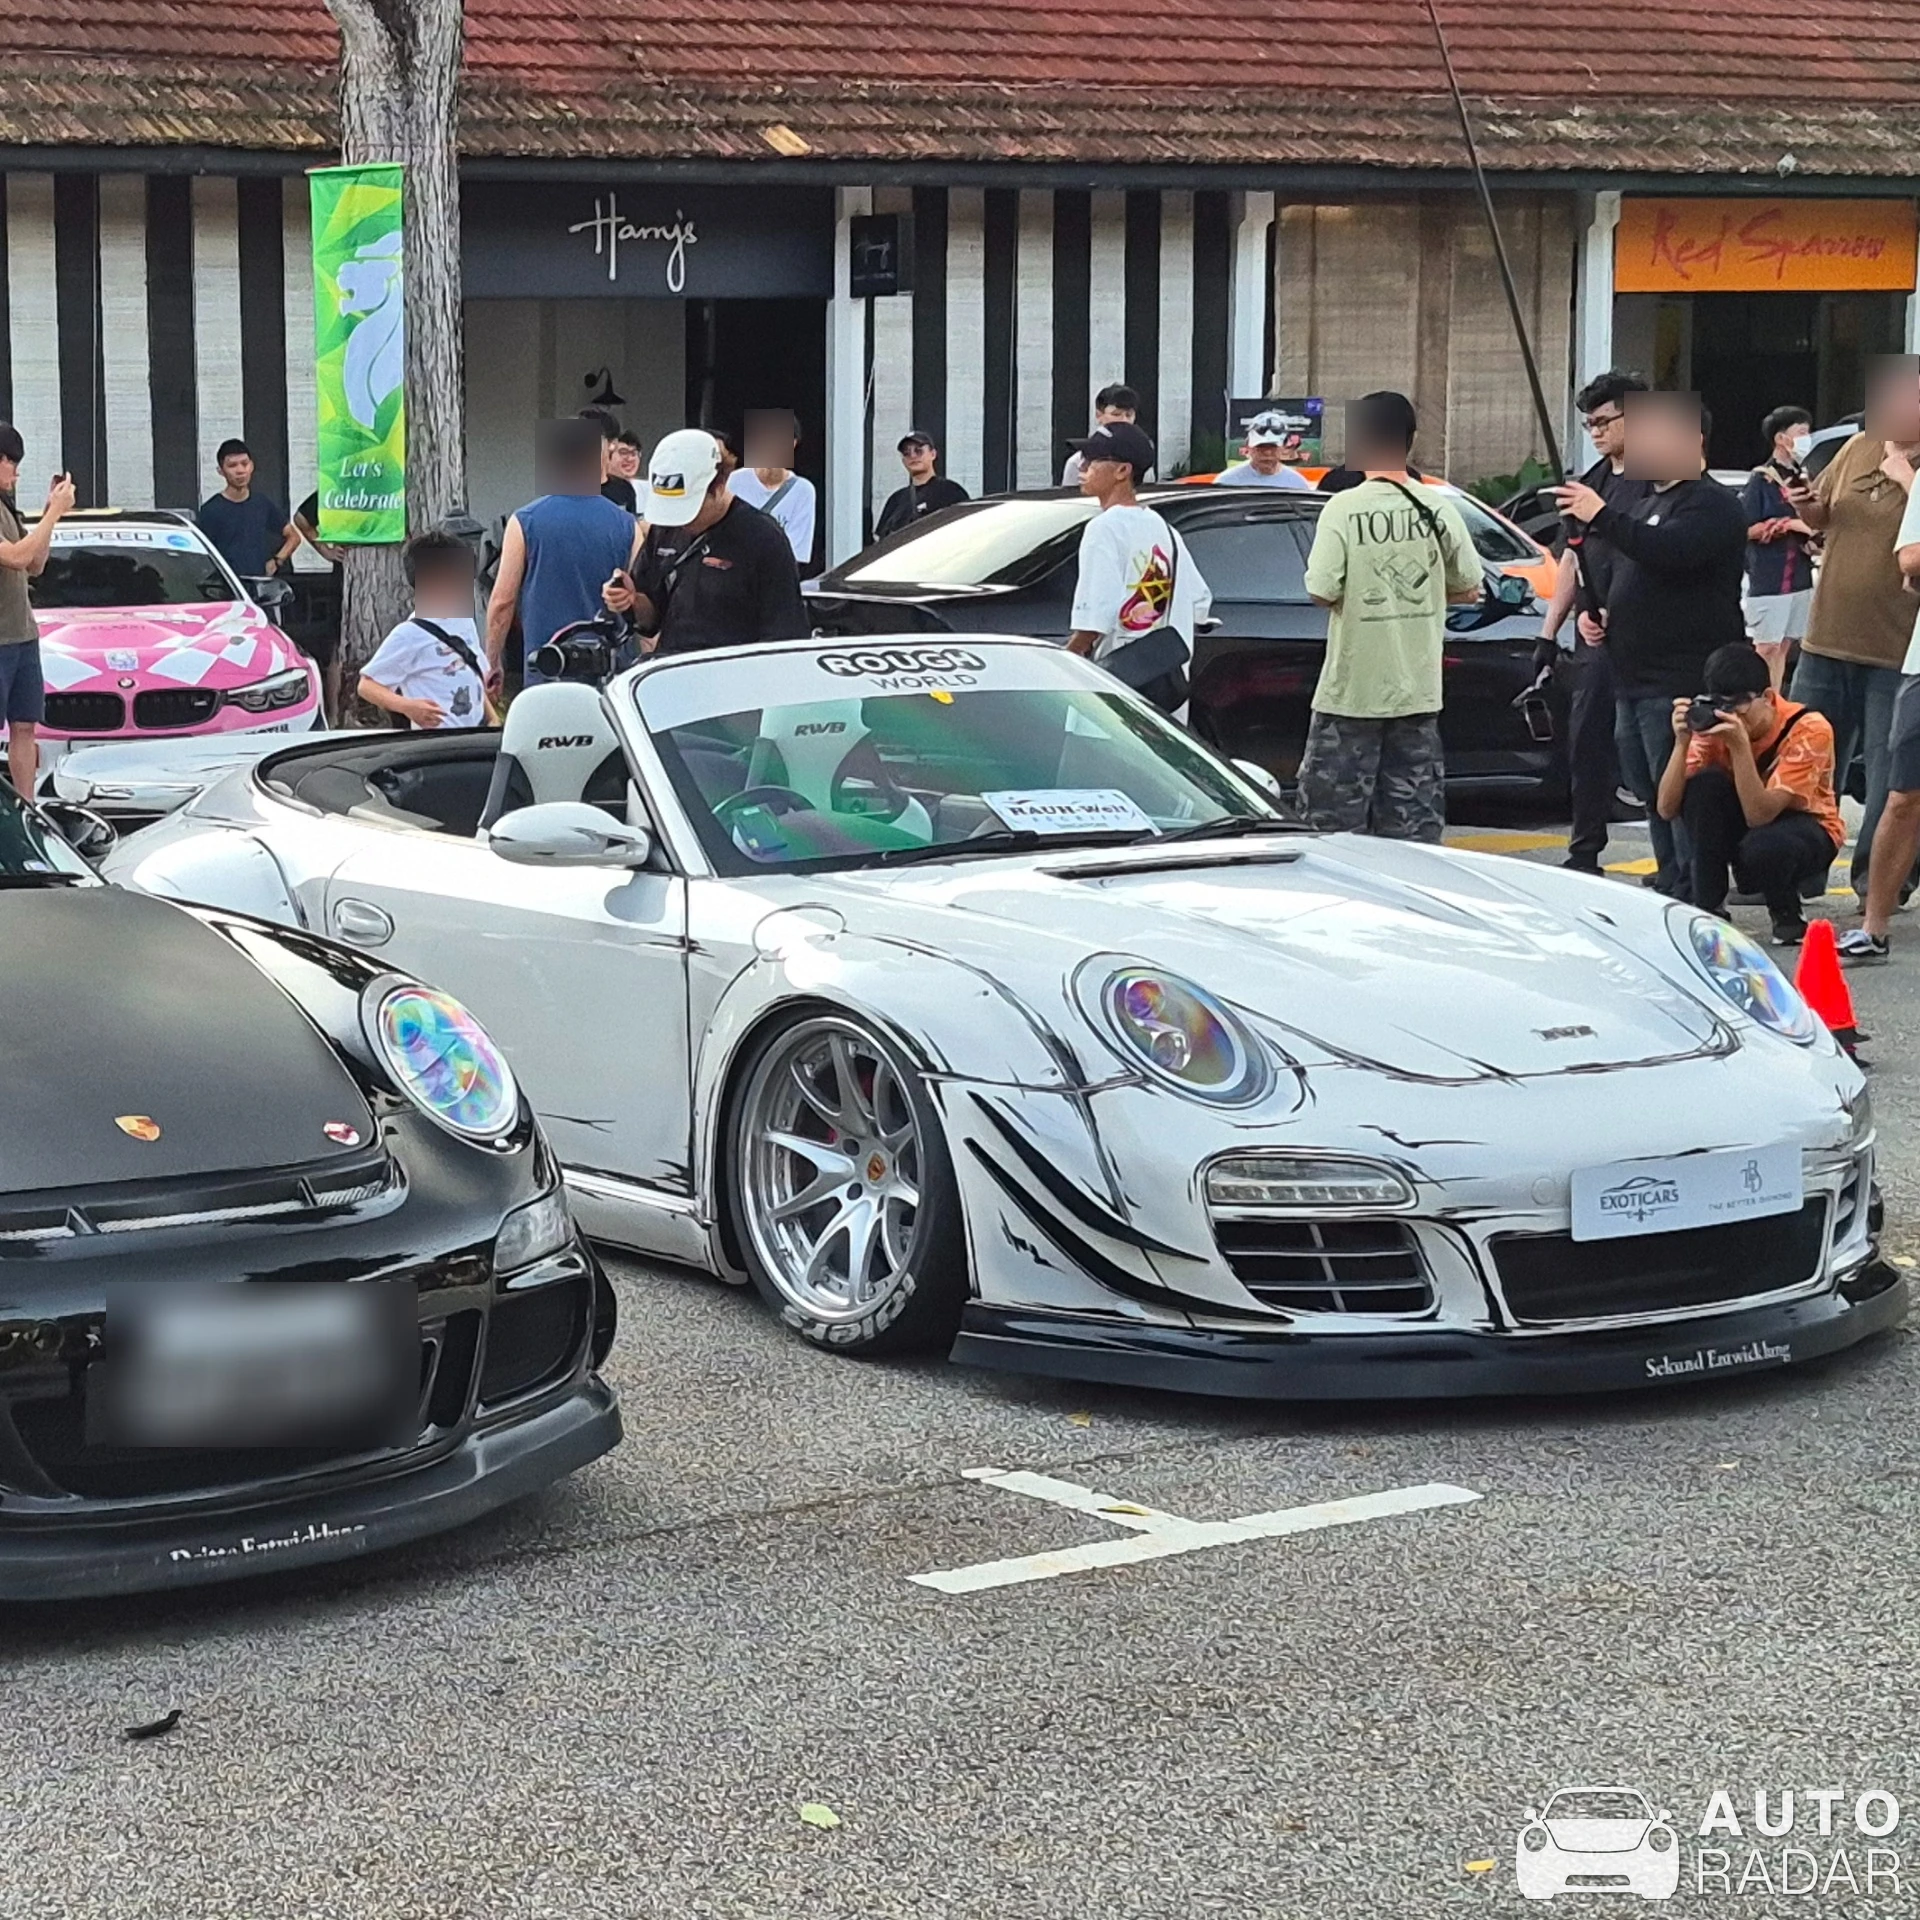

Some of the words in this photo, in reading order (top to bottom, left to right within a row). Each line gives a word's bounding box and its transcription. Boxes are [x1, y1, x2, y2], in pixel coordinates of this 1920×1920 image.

[568, 191, 698, 293] Harry's
[1650, 208, 1736, 281] Red
[1737, 208, 1887, 281] Sparrow
[339, 456, 384, 478] Let's
[324, 487, 402, 509] Celebrate
[817, 649, 986, 676] ROUGH
[870, 674, 978, 689] WORLD
[794, 721, 847, 737] RWB
[537, 735, 595, 750] RWB
[1600, 1188, 1680, 1210] EXOTICARS
